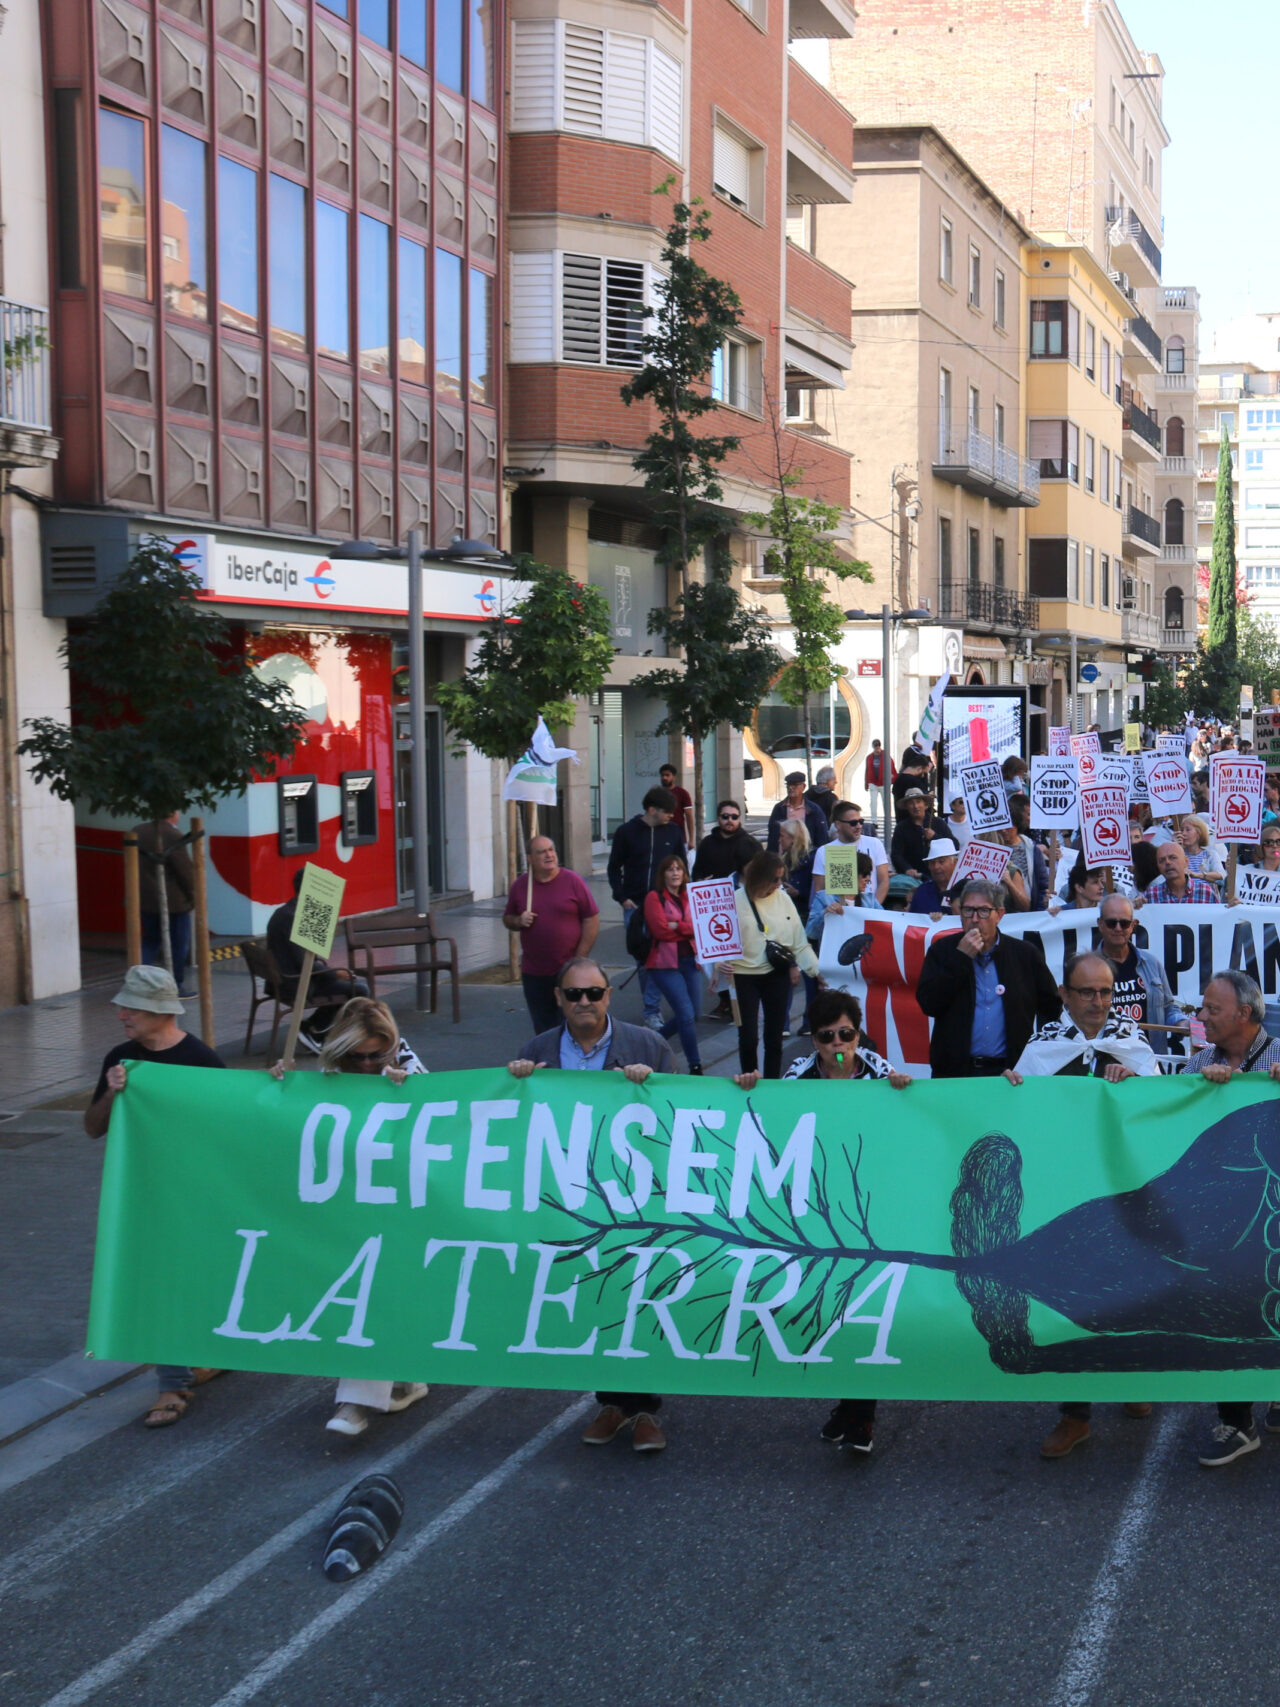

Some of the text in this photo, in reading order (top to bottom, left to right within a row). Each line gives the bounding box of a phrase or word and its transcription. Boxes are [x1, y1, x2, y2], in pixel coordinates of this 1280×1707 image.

[227, 554, 298, 591] iberCaja
[968, 704, 982, 712] BEST
[1256, 717, 1269, 725] ELS
[1257, 728, 1274, 738] HAN
[965, 767, 998, 780] NO A LA
[1103, 772, 1126, 781] STOP
[1154, 770, 1181, 781] STOP
[1221, 768, 1259, 779] NO A LA
[967, 781, 1000, 793] DE BIOGAS
[1041, 779, 1070, 789] STOP
[1153, 783, 1185, 794] BIOGAS
[1042, 798, 1068, 809] BIO
[1084, 792, 1124, 804] NO A LA
[1086, 810, 1095, 818] DE
[968, 847, 1004, 862] NO A LA
[974, 862, 999, 873] BIOGAS
[1241, 873, 1270, 891] NO
[695, 887, 732, 901] NO A LA
[1239, 891, 1273, 903] MACRO
[712, 903, 735, 913] BIOGAS
[299, 1099, 817, 1219] DEFENSEM
[213, 1229, 910, 1365] LA TERRA
